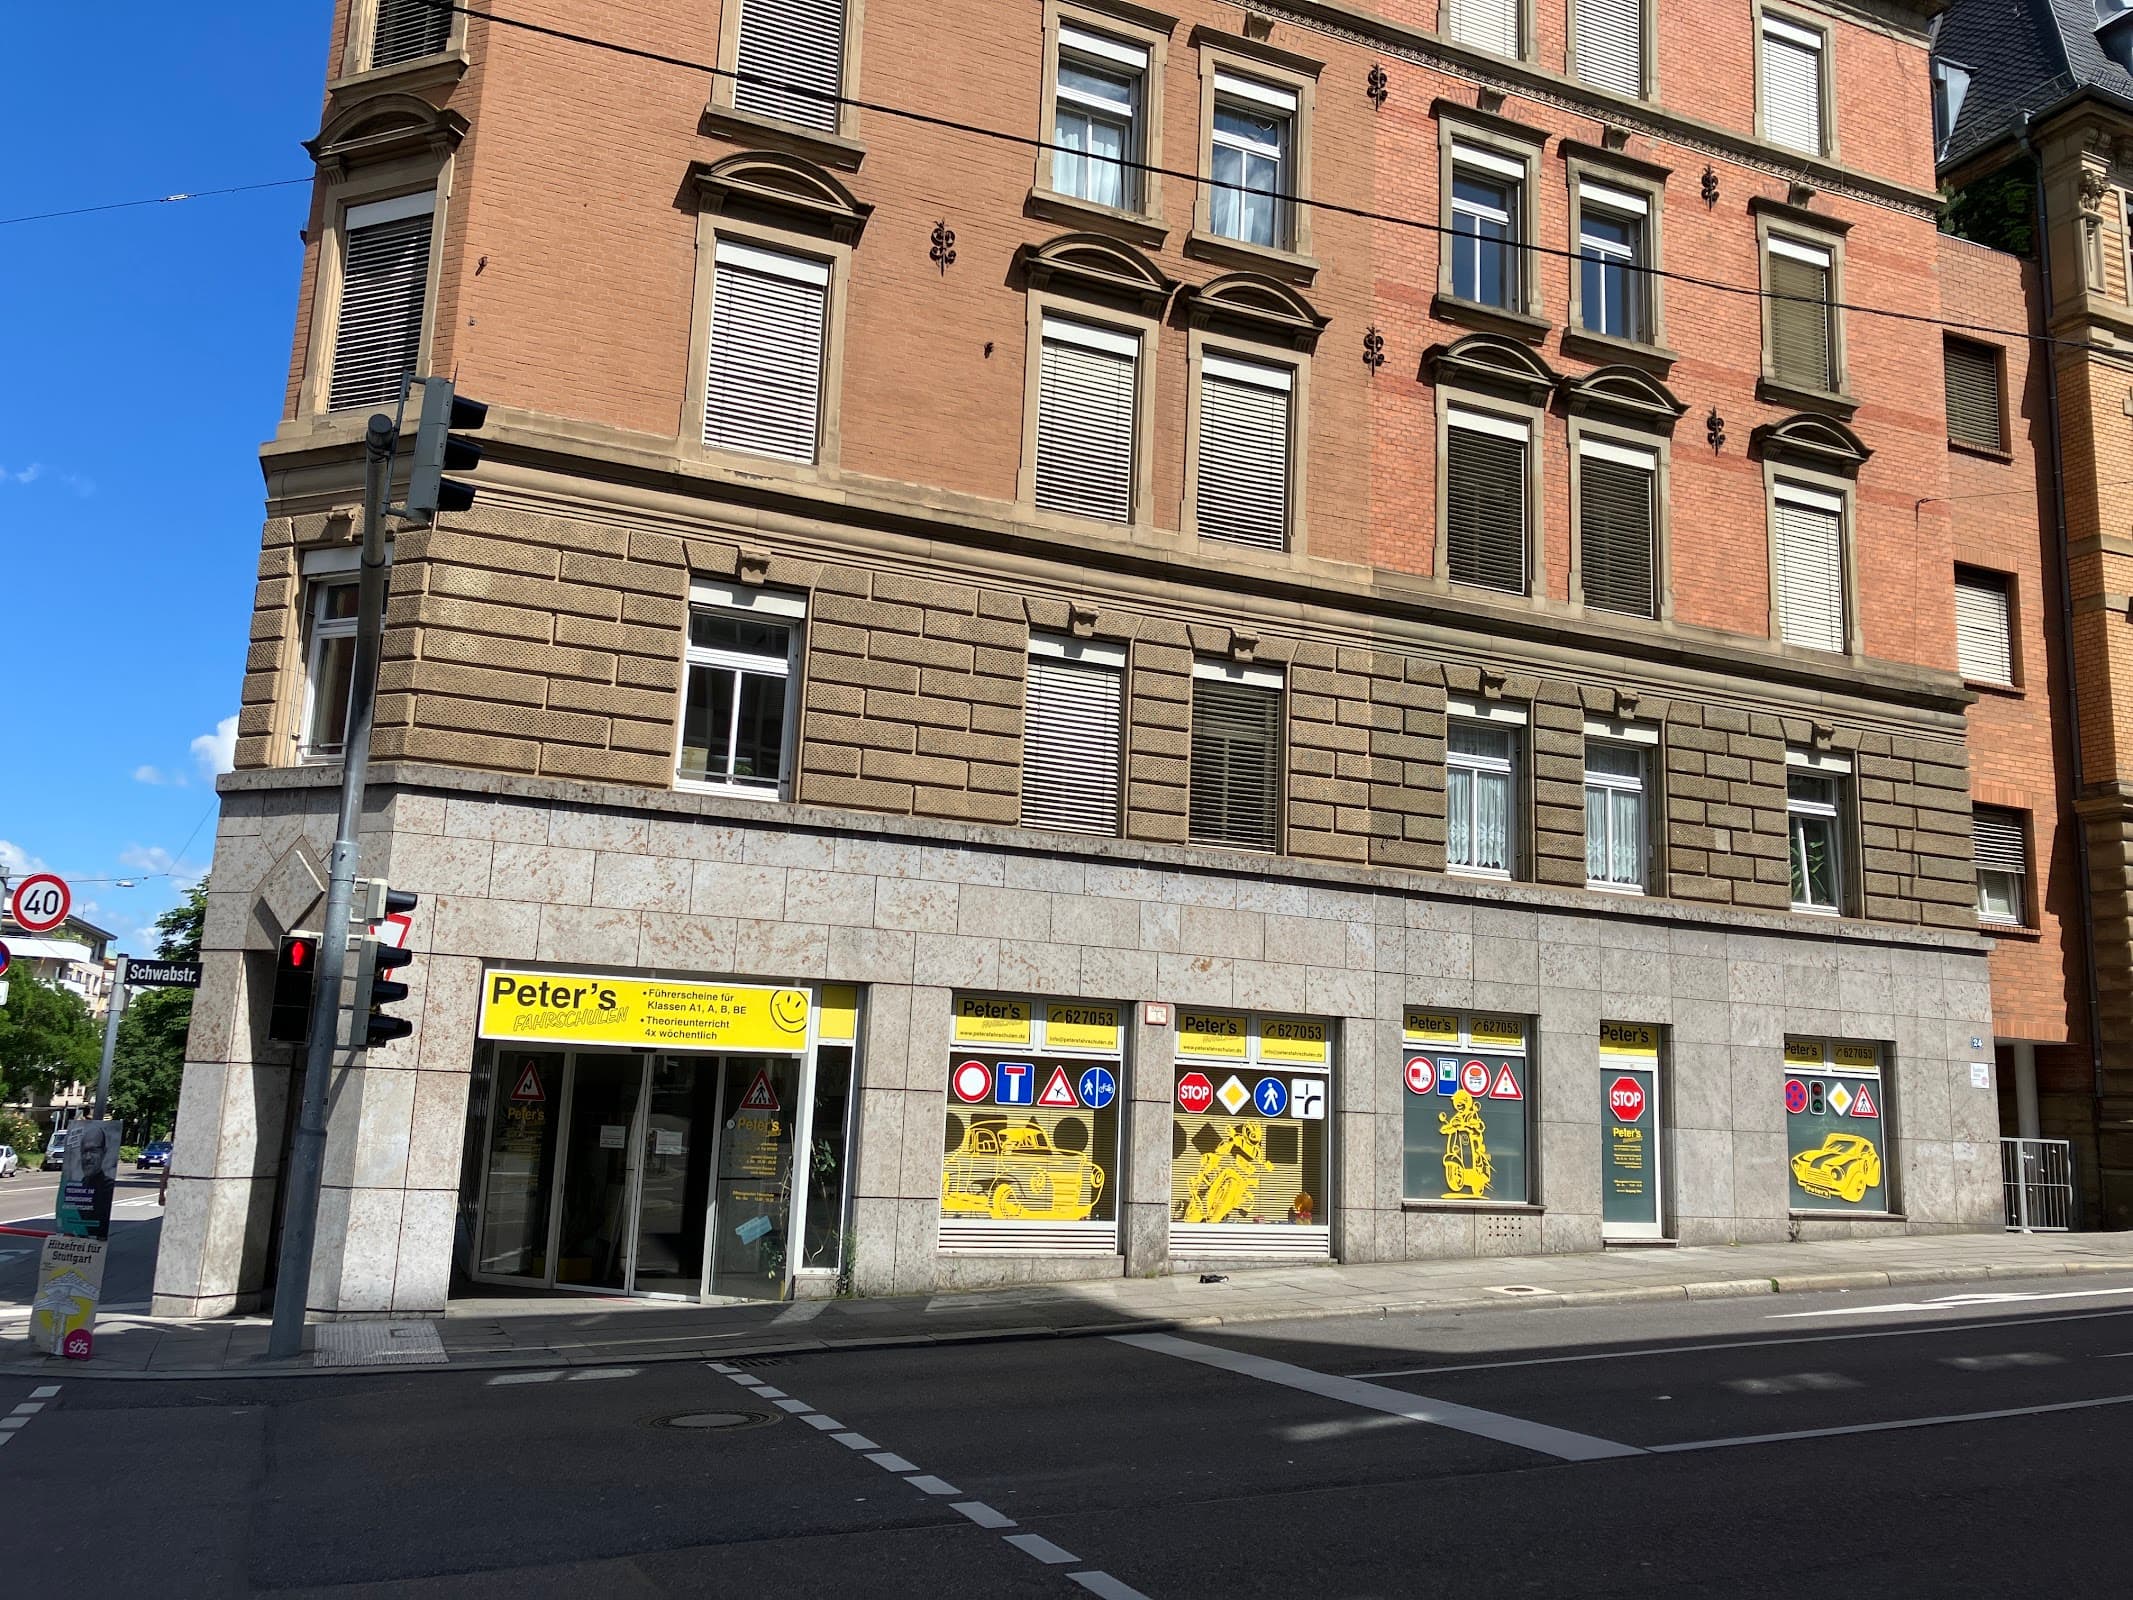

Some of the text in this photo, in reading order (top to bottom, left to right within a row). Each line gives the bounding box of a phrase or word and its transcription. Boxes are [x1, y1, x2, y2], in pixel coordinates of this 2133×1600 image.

[23, 890, 59, 915] 40
[129, 963, 197, 983] Schwabstr.
[492, 976, 617, 1011] Peter's
[648, 989, 734, 1002] Führerscheine für
[647, 1001, 747, 1015] Klassen A1, A, B, BE
[963, 1000, 1021, 1019] Peter's
[513, 1006, 630, 1032] FAHRSCHULEN
[646, 1016, 729, 1028] Theorieunterricht
[1065, 1010, 1113, 1026] 627053
[1185, 1016, 1237, 1034] Peter's
[1410, 1015, 1452, 1031] Peter's
[645, 1028, 717, 1040] 4x wöchentlich
[1278, 1024, 1322, 1039] 627053
[1484, 1021, 1519, 1034] 627053
[1600, 1024, 1649, 1043] Peter's
[1785, 1042, 1818, 1056] Peter's
[1844, 1047, 1873, 1059] 627053
[1181, 1085, 1209, 1101] STOP
[1613, 1091, 1641, 1107] STOP
[507, 1107, 545, 1121] Peter's
[737, 1117, 780, 1132] Peter's
[1613, 1127, 1642, 1138] Peter's
[48, 1240, 102, 1254] Hitzefrei für
[52, 1251, 92, 1265] Stuttgart
[69, 1338, 89, 1355] SÖS
